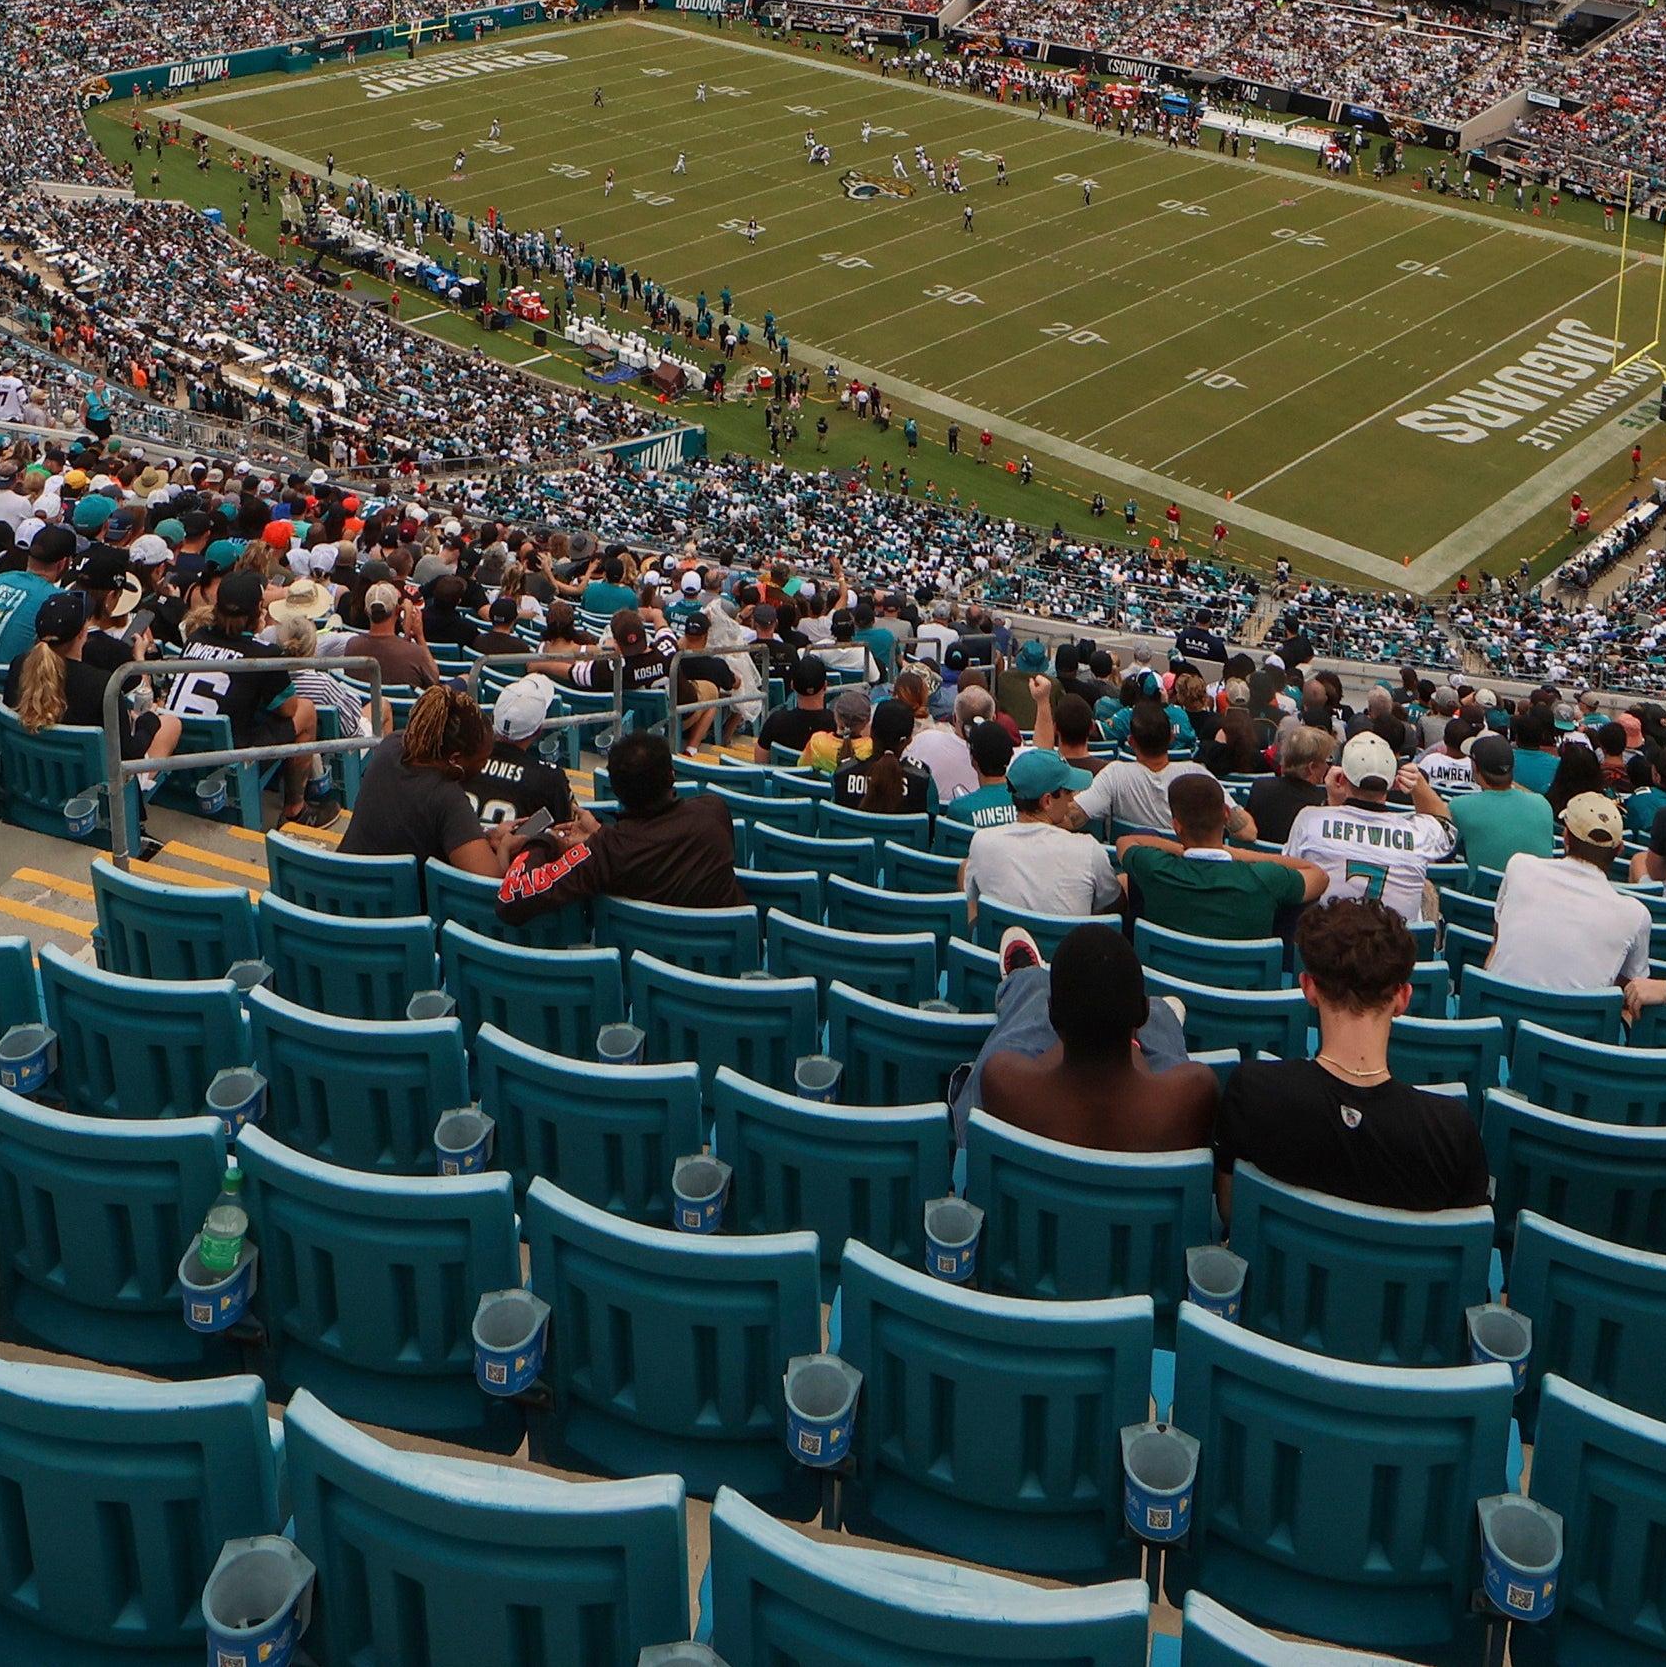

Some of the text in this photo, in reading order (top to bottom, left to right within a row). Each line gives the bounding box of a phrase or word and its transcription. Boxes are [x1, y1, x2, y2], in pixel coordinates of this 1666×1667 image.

[358, 49, 512, 83] JACKSONVILLE
[361, 51, 569, 99] JAGUARS
[549, 162, 591, 179] 30
[819, 251, 864, 270] 40
[921, 284, 974, 304] 30
[1039, 322, 1099, 343] 20
[1185, 367, 1236, 390] 10
[1395, 318, 1626, 444] JAGUARS
[1517, 359, 1666, 452] JACKSONVILLE
[634, 663, 664, 681] KOSAR
[168, 671, 232, 717] 16
[481, 759, 525, 782] JONES
[1322, 820, 1414, 851] LEFTWICH
[1345, 859, 1389, 902] 7
